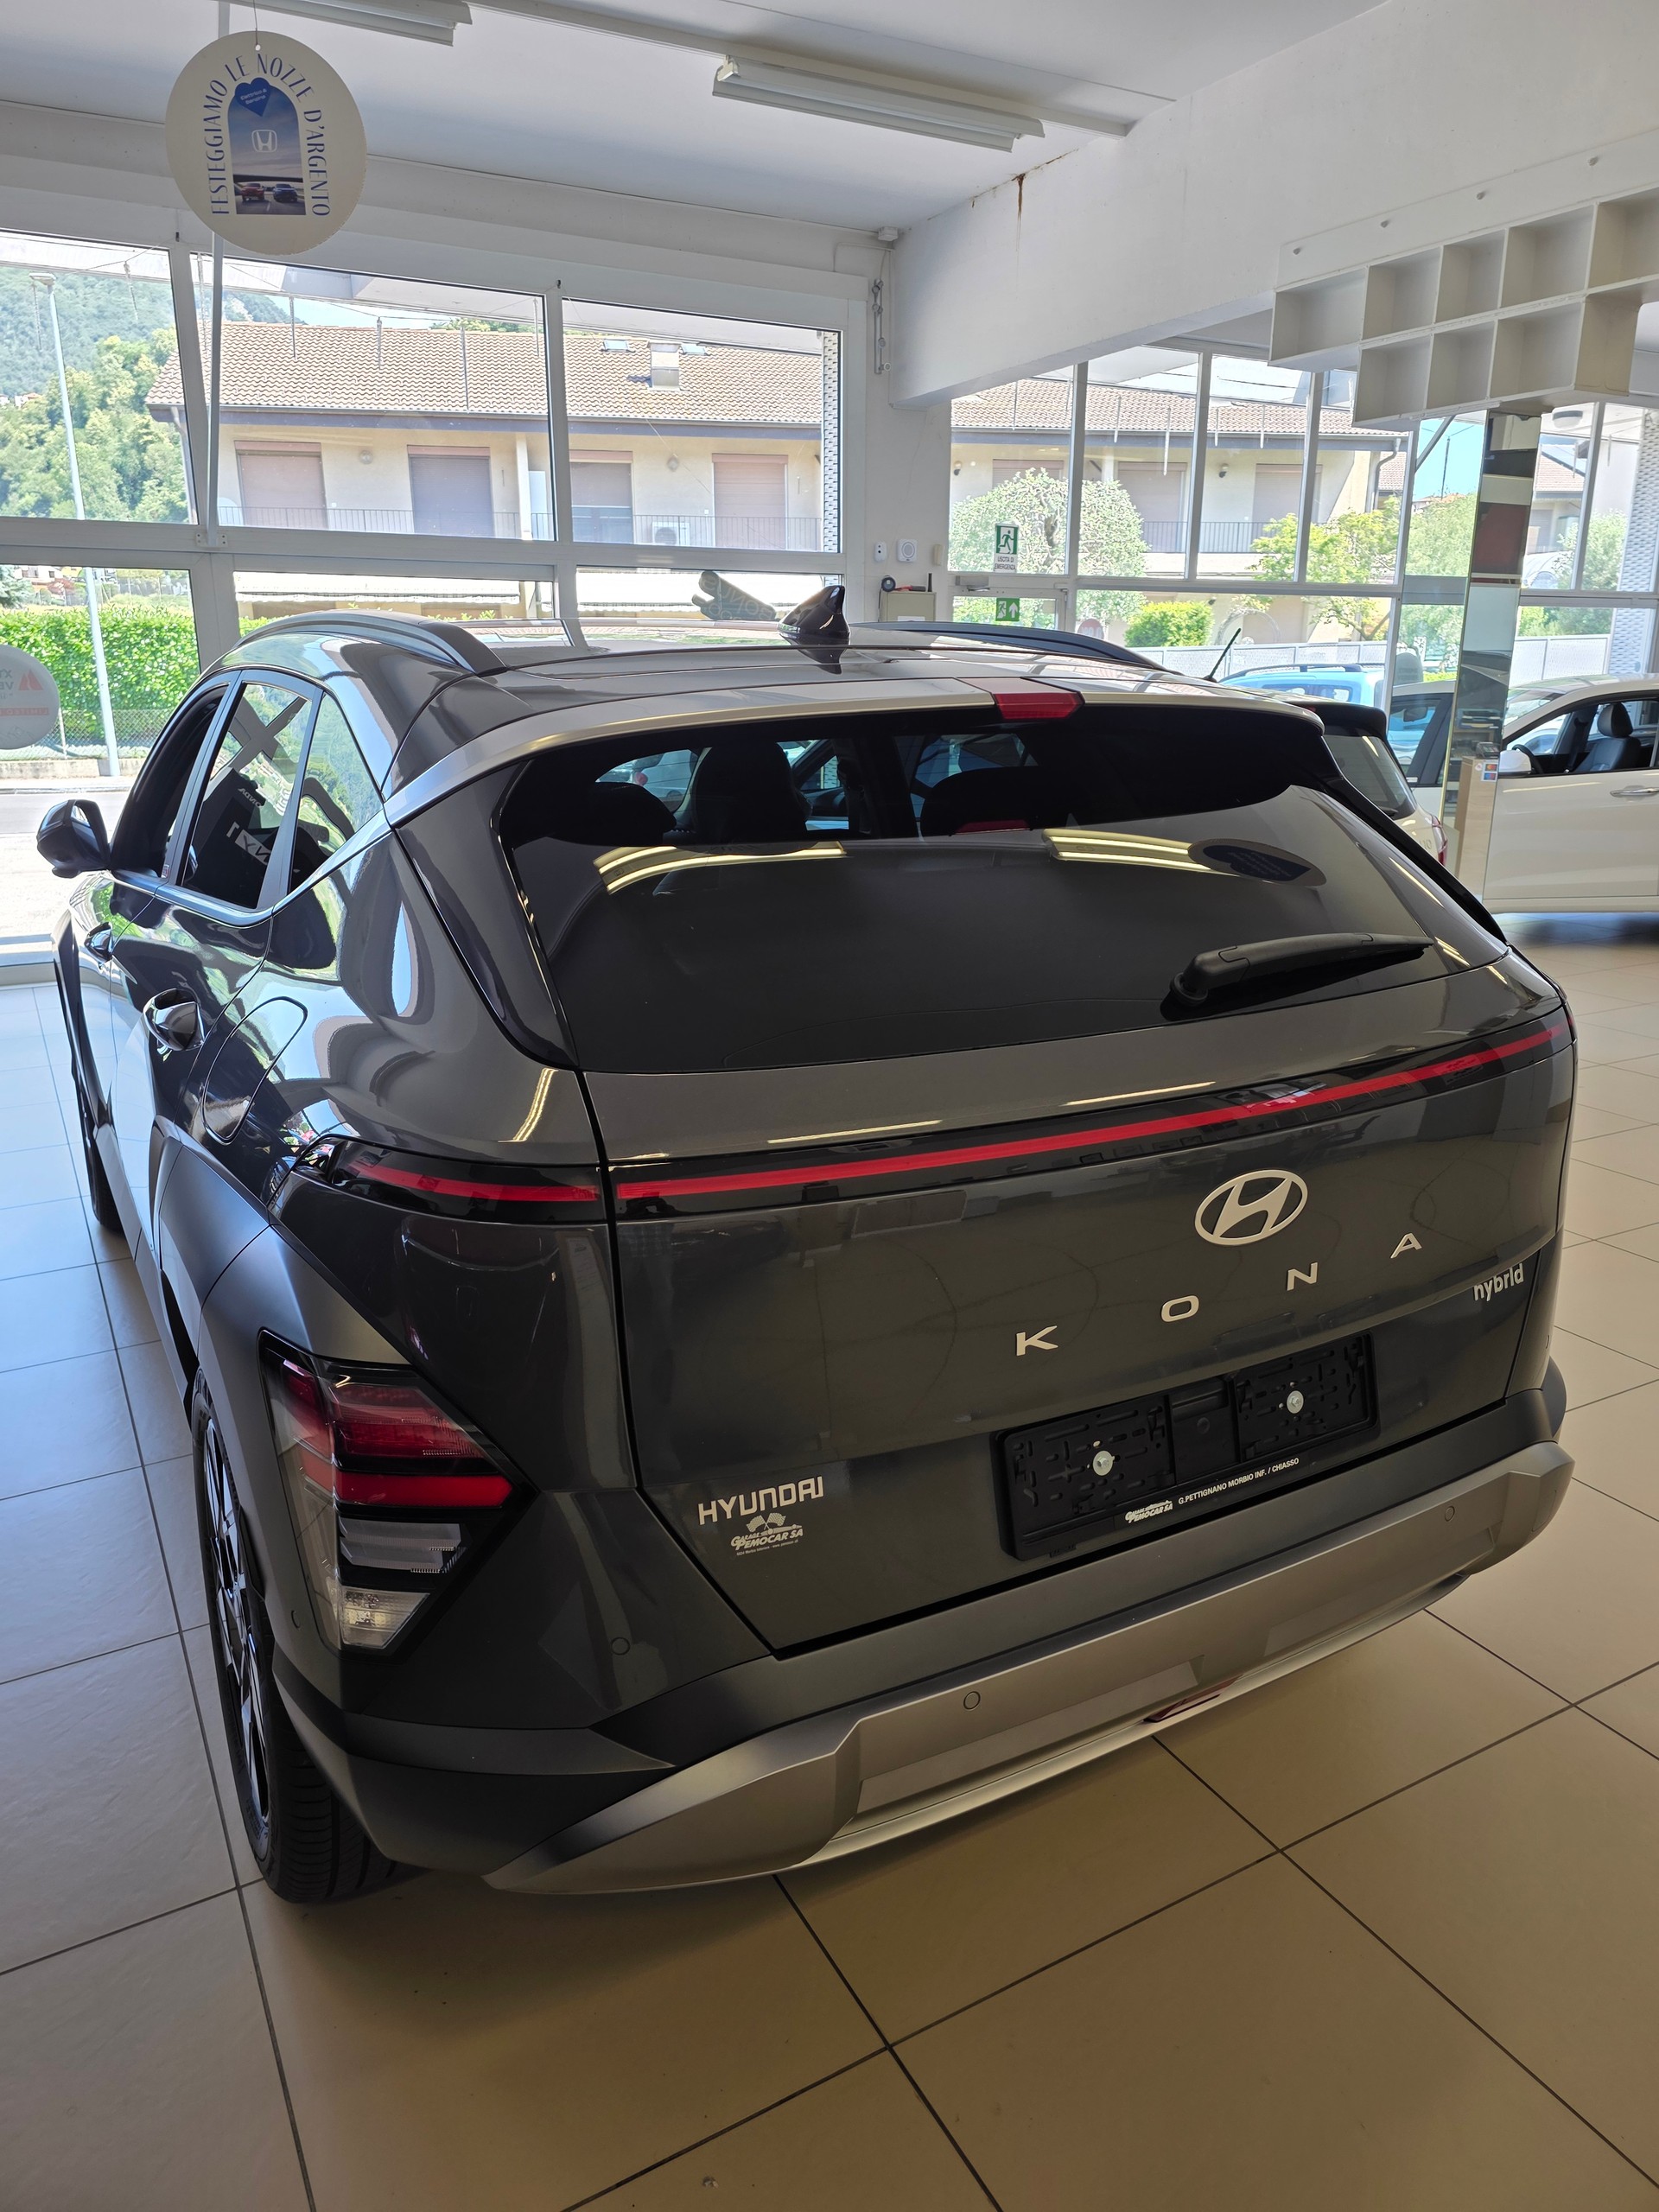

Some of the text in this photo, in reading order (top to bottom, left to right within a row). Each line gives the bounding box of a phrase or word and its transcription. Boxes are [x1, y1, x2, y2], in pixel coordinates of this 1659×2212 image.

[203, 53, 331, 216] FESTEGGIAMO LE NOZZE D'ARGENTO
[1015, 1232, 1423, 1357] KONA
[1473, 1262, 1524, 1302] hybrid
[1228, 1473, 1254, 1488] MORBIO
[1255, 1470, 1267, 1479] INF.
[1272, 1458, 1300, 1472] CHIASSO
[697, 1476, 824, 1526] HYUNDAI
[789, 1529, 804, 1539] SA
